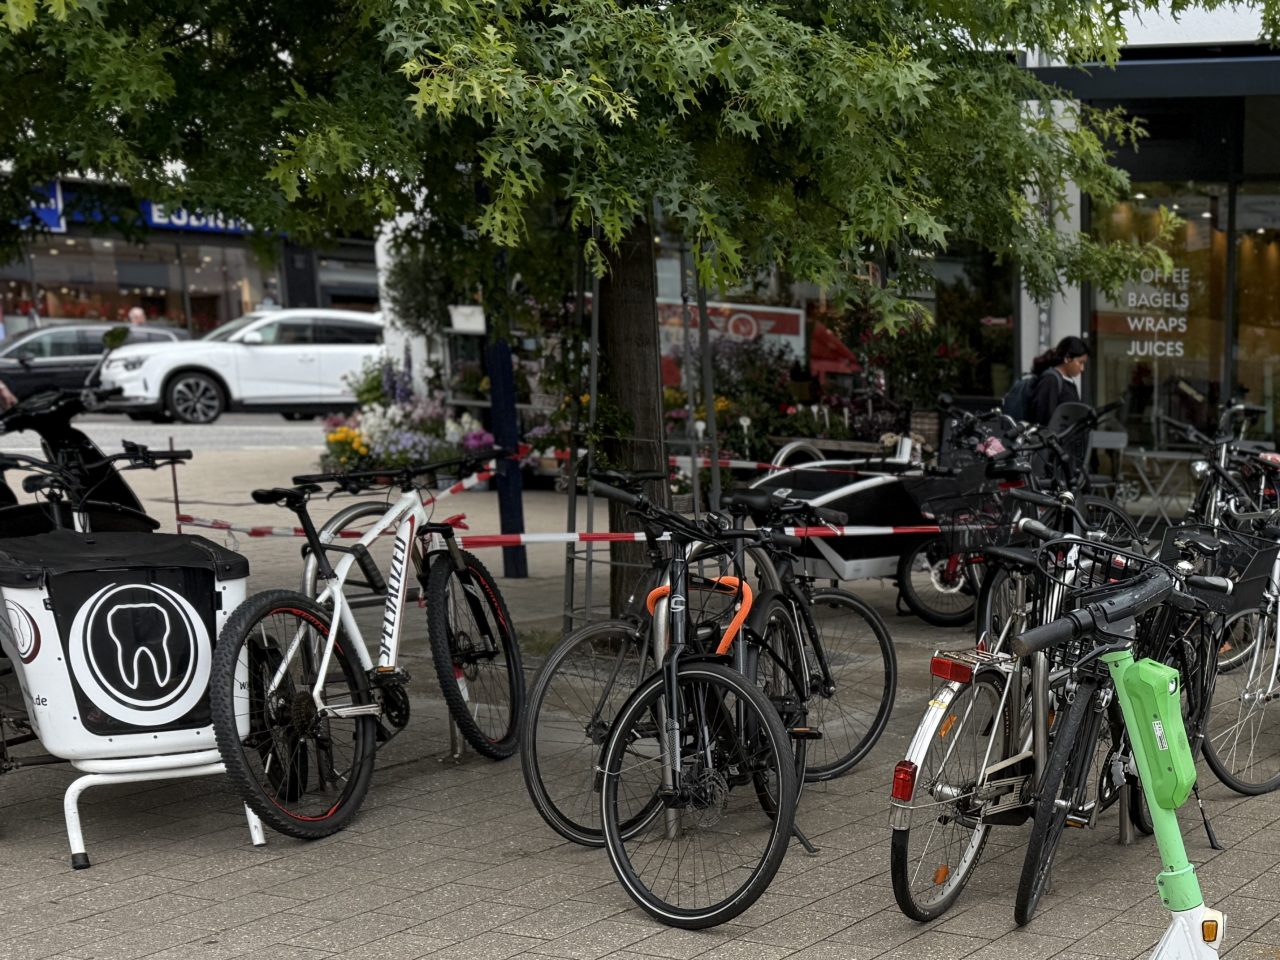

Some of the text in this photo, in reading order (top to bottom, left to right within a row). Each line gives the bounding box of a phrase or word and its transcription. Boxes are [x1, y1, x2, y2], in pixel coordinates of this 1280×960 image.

[1136, 268, 1190, 284] OFFEE
[1127, 292, 1189, 309] BAGELS
[1126, 316, 1188, 333] WRAPS
[1126, 340, 1184, 357] JUICES
